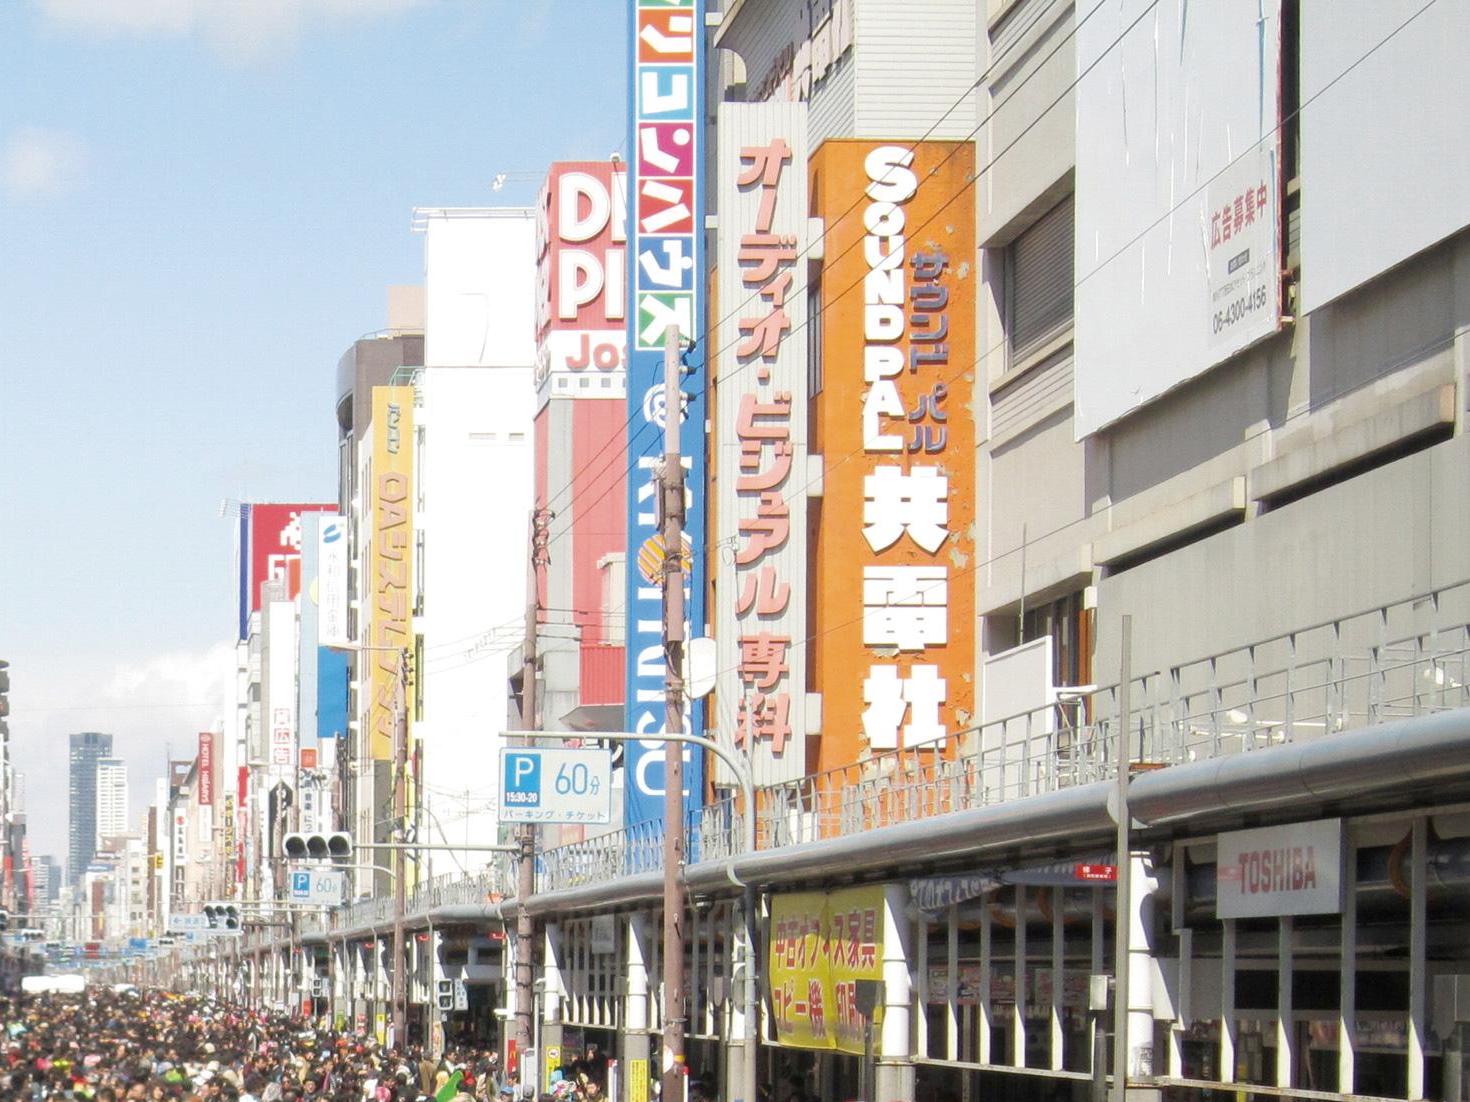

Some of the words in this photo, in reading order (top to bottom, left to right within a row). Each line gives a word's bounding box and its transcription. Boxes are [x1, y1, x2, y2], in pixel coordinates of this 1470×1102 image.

[640, 0, 692, 346] リコンハウス
[1210, 178, 1267, 250] 広告募集中
[565, 333, 626, 371] Jo
[861, 465, 950, 749] 共電社
[515, 757, 534, 787] P
[555, 762, 600, 796] 60分
[1238, 846, 1317, 894] TOSHIBA
